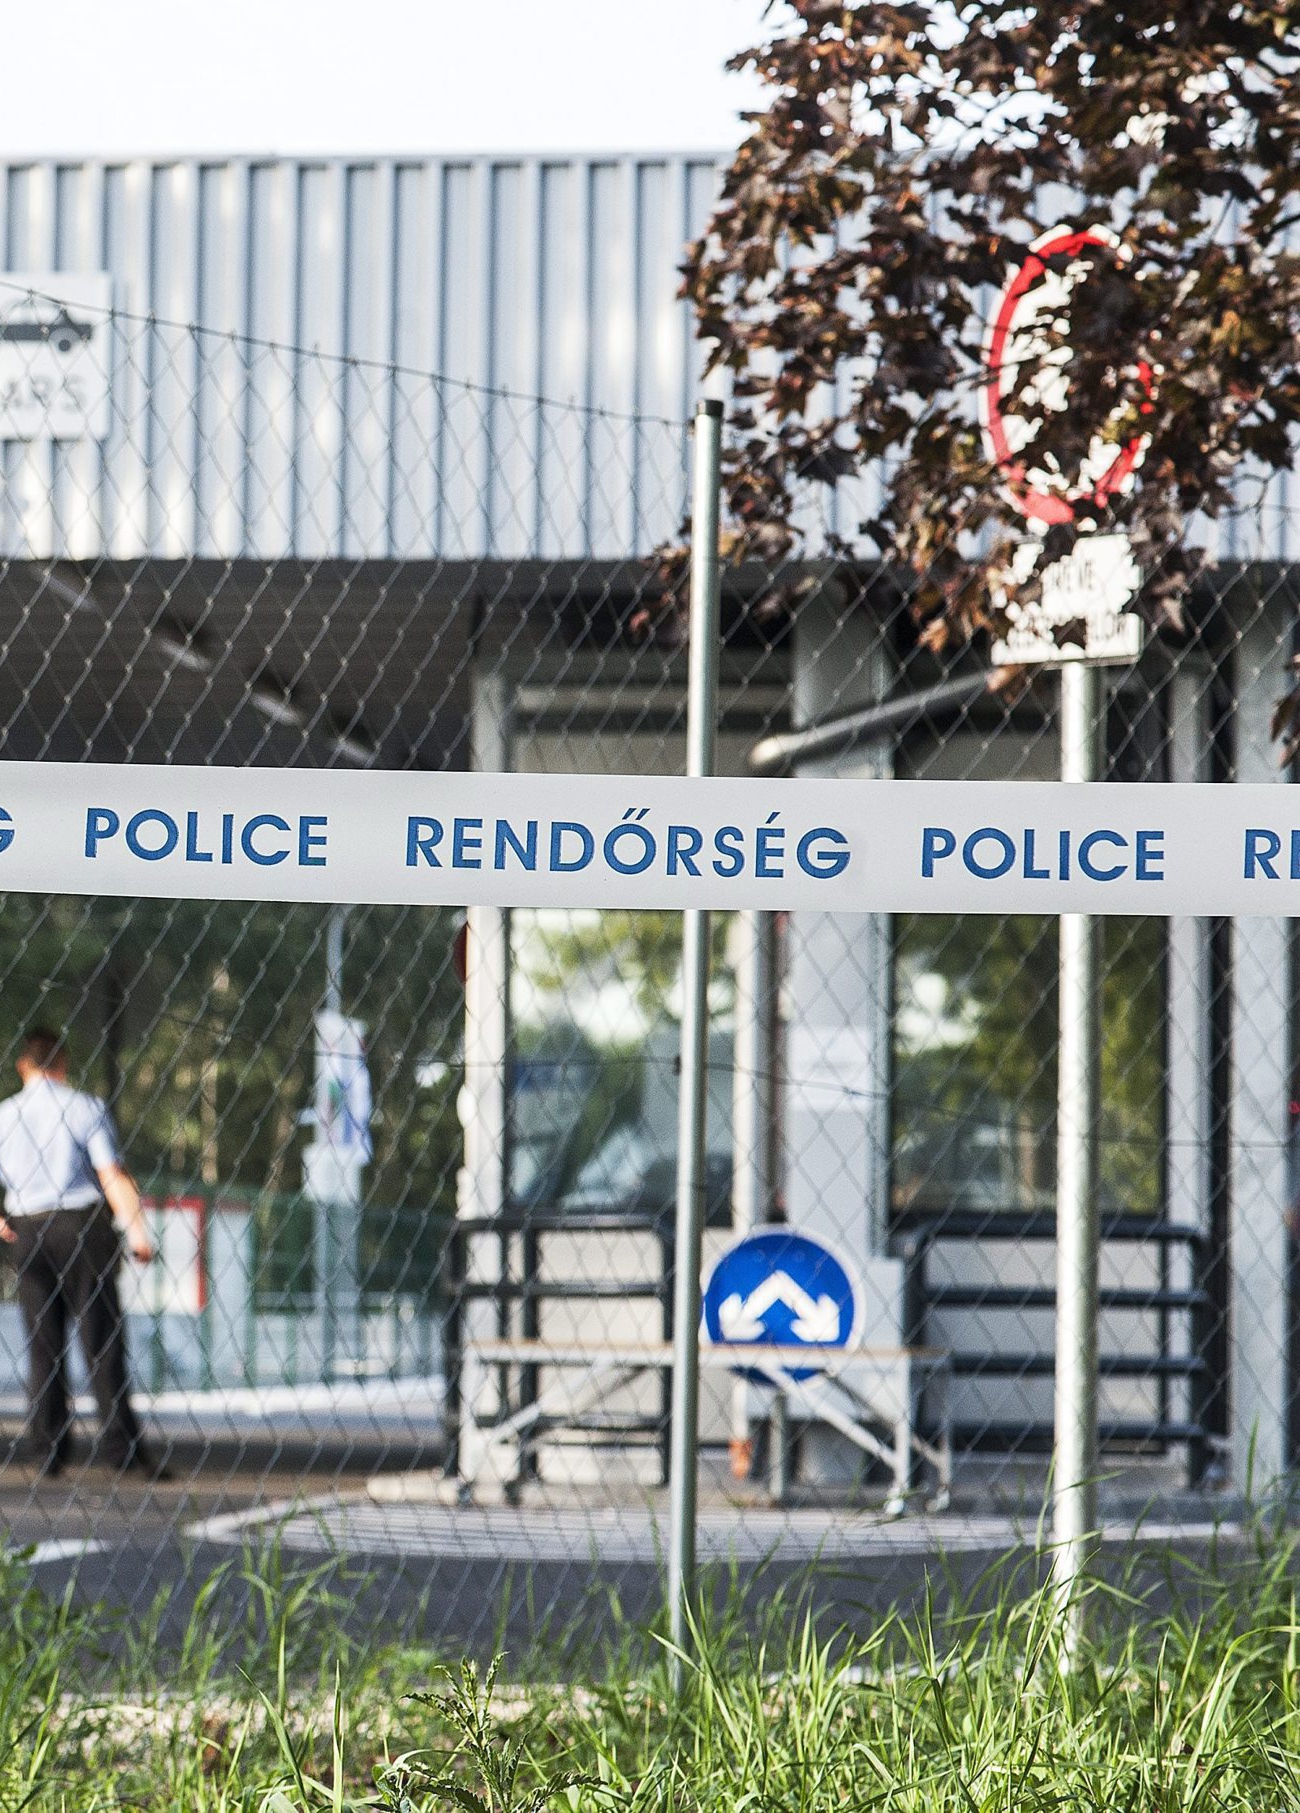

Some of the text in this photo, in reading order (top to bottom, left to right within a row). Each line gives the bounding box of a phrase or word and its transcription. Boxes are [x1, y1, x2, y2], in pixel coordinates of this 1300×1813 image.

[85, 808, 329, 867] POLICE
[406, 807, 852, 881] RENDŐRSÉG
[922, 828, 1166, 883] POLICE
